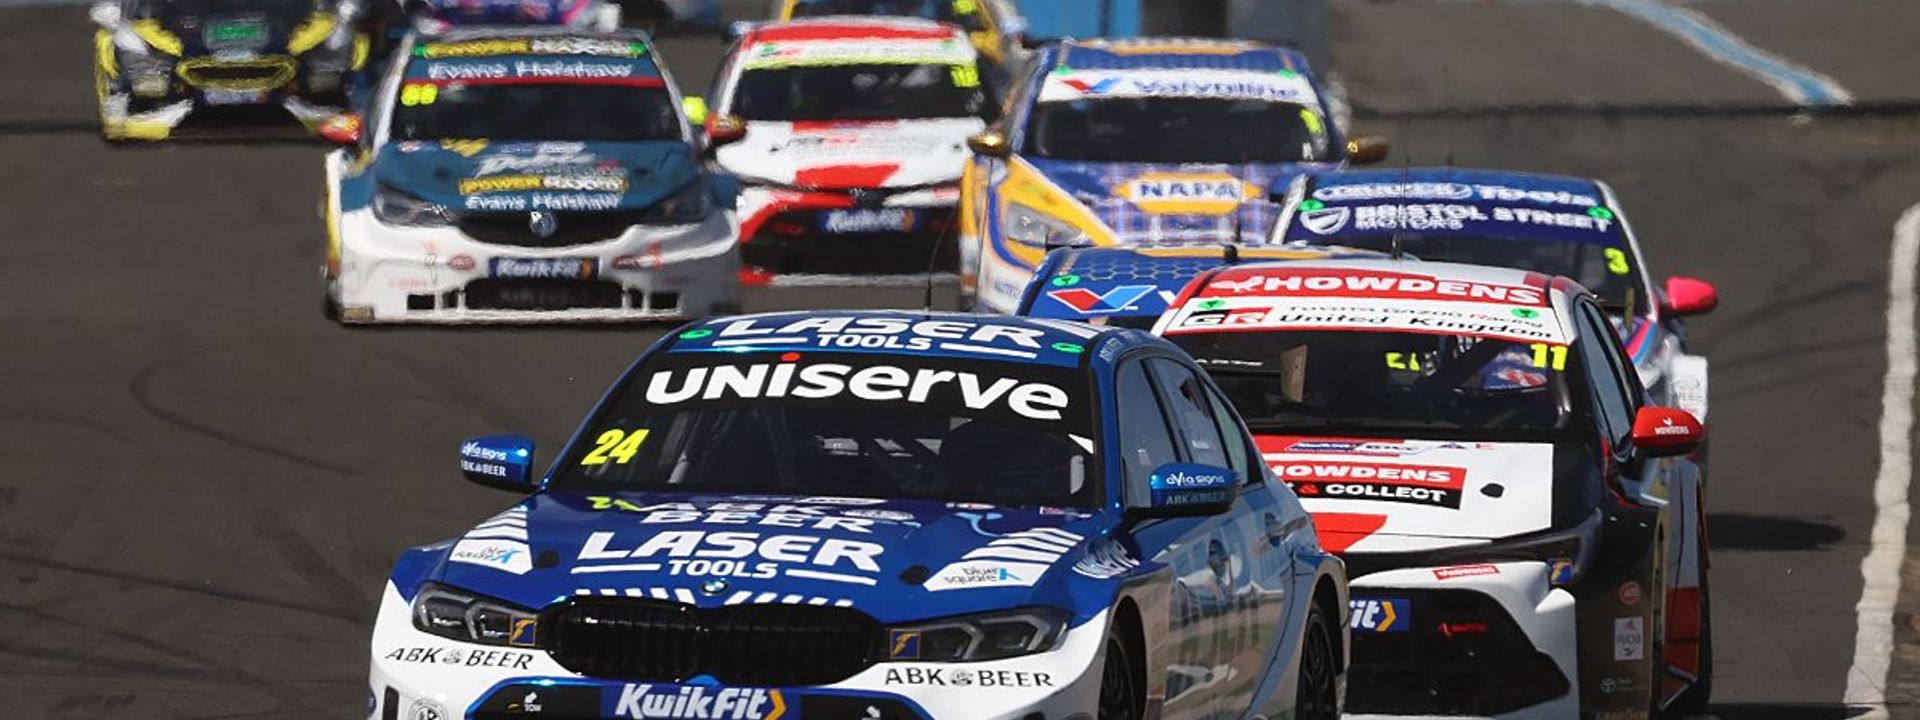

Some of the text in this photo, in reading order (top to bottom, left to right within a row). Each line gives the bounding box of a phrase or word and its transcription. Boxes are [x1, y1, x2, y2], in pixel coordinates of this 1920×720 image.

[427, 59, 635, 80] Evans Halshaw
[1140, 181, 1236, 197] NAPA
[1473, 184, 1597, 206] Tools
[465, 191, 624, 211] Evans Halshaw
[1355, 204, 1612, 233] BRISTOL STREET
[1355, 218, 1464, 230] MOTORS
[1604, 247, 1629, 275] 3
[1264, 275, 1543, 305] HOWDENS
[1181, 311, 1267, 327] GR
[1279, 313, 1553, 339] United Kingdom
[718, 317, 1045, 348] LASER
[817, 332, 931, 350] TOOLS
[1531, 343, 1569, 370] 11
[581, 429, 651, 465] 24
[482, 464, 506, 476] BEER
[1326, 483, 1448, 502] COLLECT
[641, 511, 874, 534] BEER
[577, 530, 884, 572] LASER
[667, 559, 778, 578] TOOLS
[1350, 600, 1380, 628] it
[384, 647, 534, 671] ABK BEER
[885, 668, 1055, 688] ABK BEER
